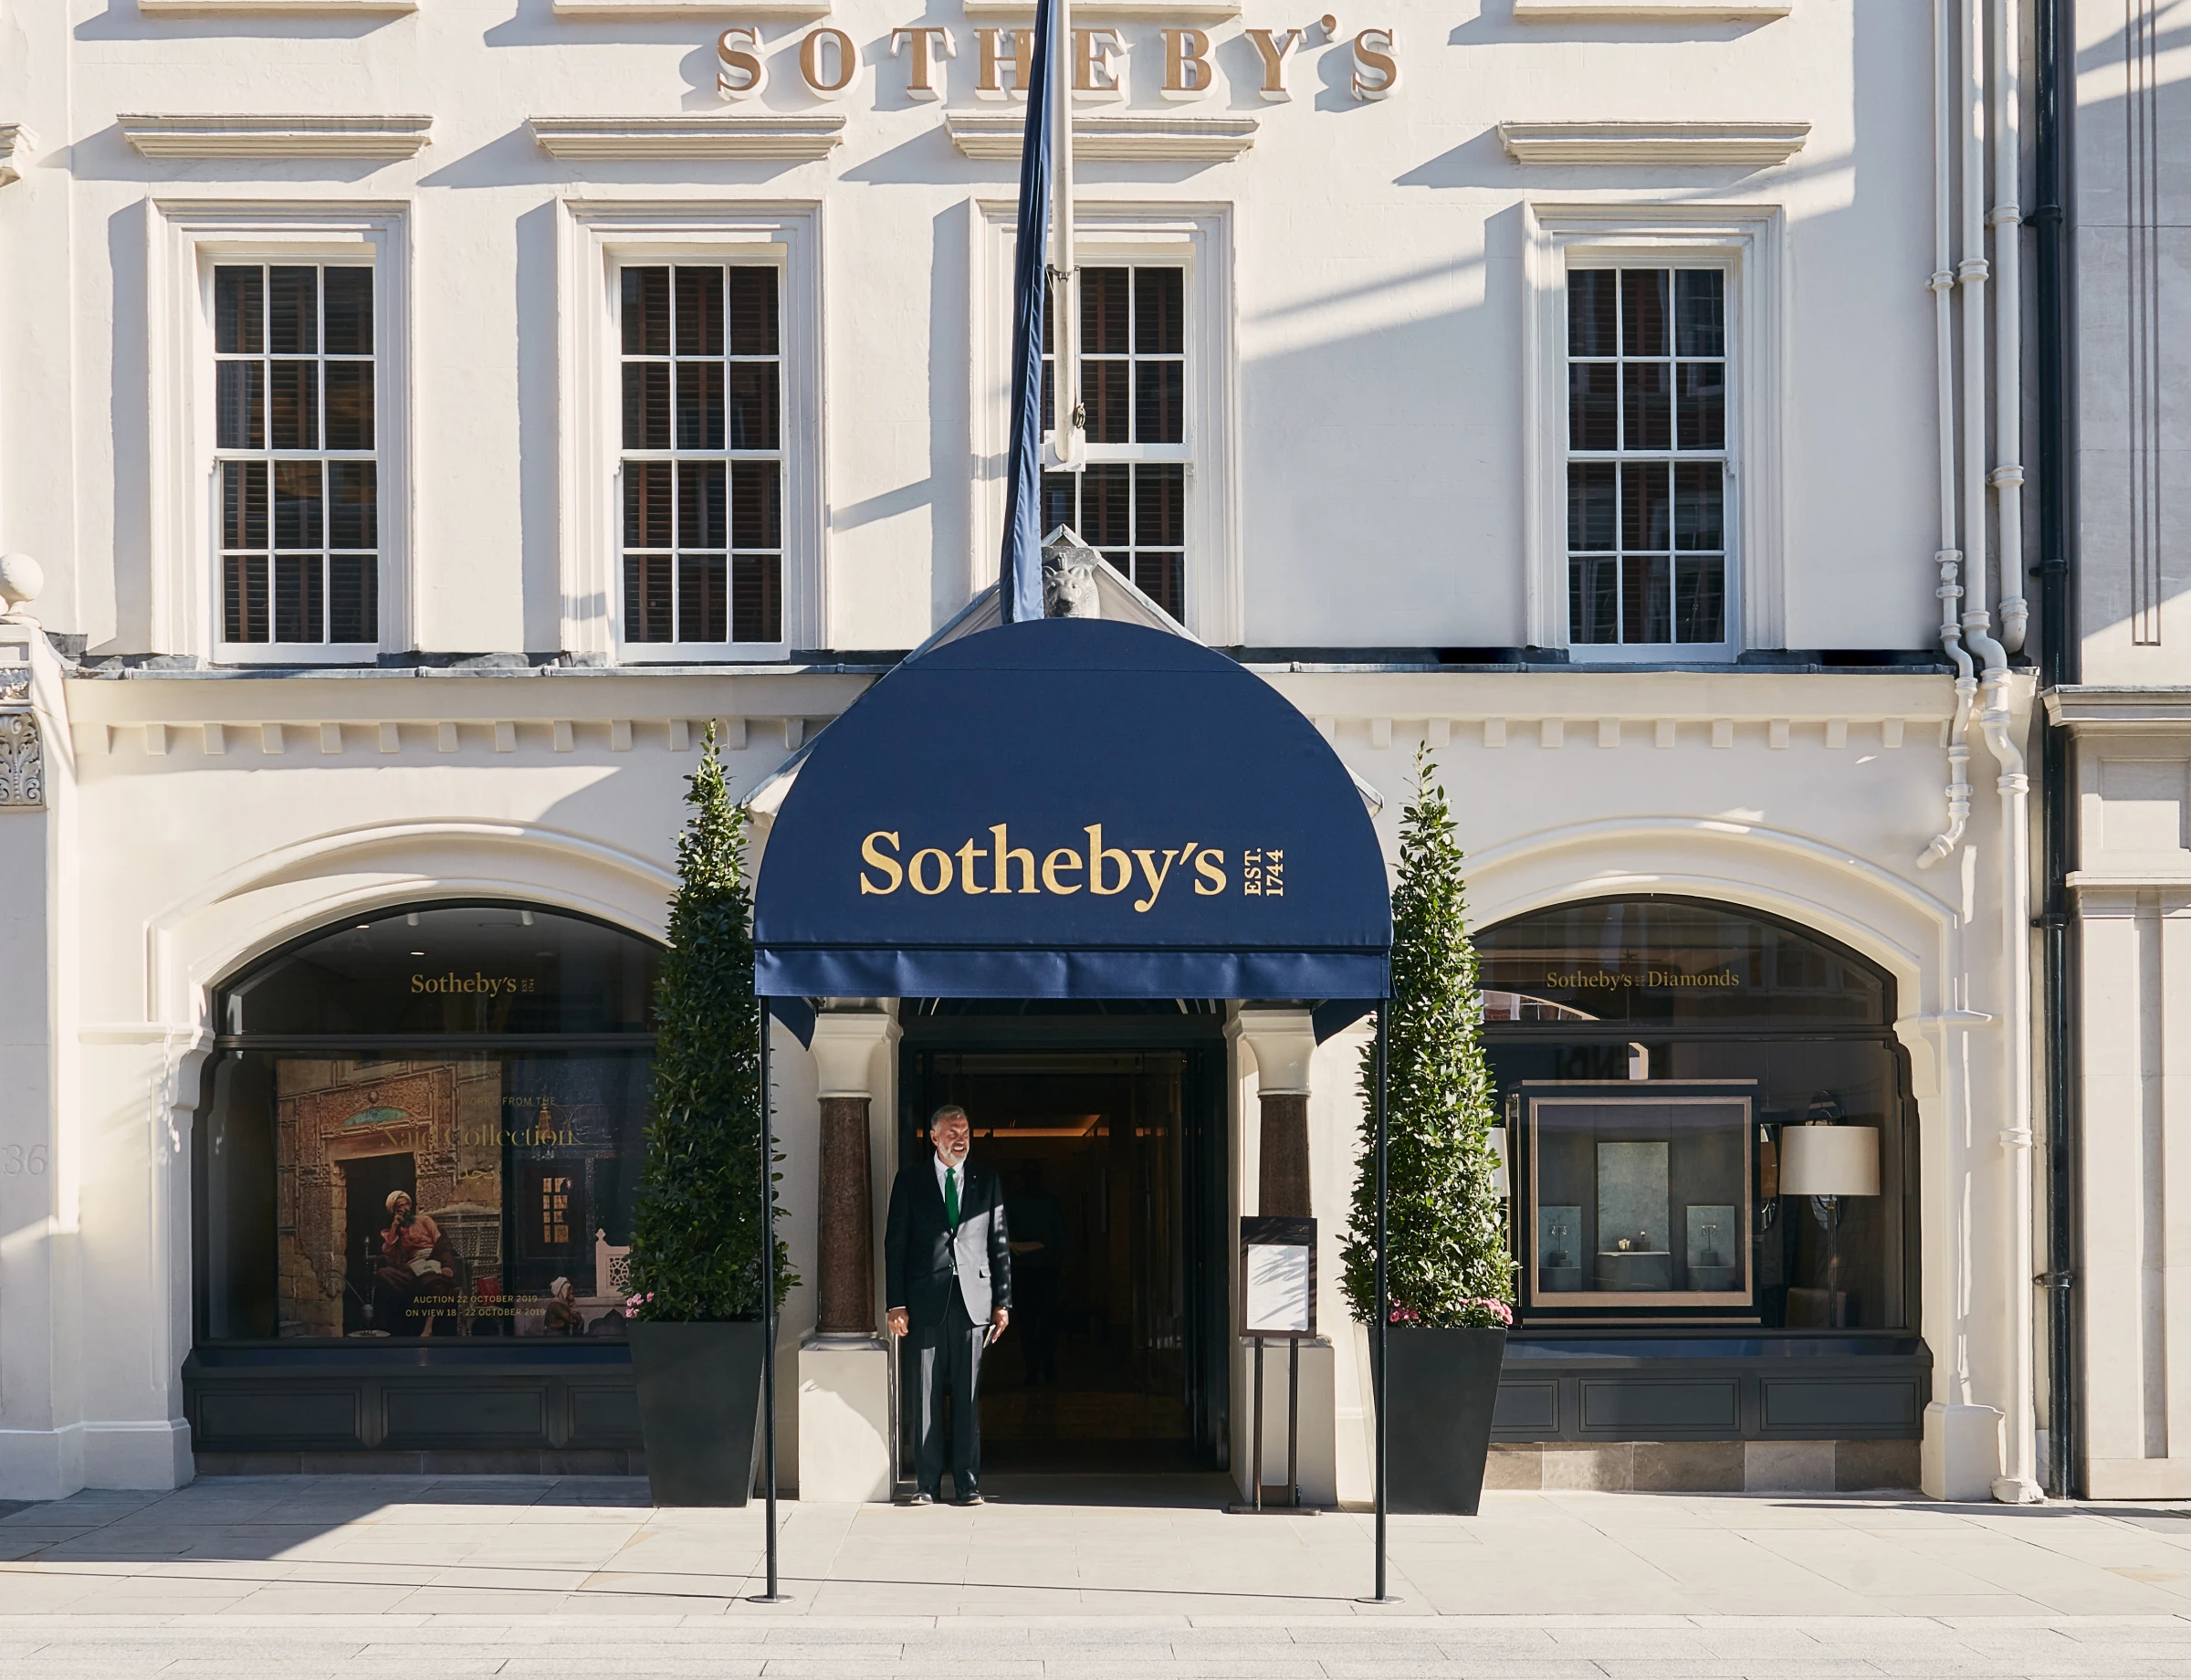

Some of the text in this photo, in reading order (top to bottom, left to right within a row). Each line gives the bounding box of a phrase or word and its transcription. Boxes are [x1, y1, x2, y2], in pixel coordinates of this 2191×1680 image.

[716, 14, 1401, 99] SOTHEBY'S
[860, 823, 1227, 913] Sotheby's
[1244, 847, 1262, 897] EST.
[1265, 849, 1284, 897] 1744
[411, 971, 518, 998] Sotheby's
[1546, 971, 1632, 992] Sotheby's
[1648, 969, 1739, 987] Diamonds
[460, 1097, 556, 1107] WORKS FROM THE
[444, 1123, 574, 1147] Collection
[2, 1143, 48, 1176] 36
[405, 1308, 420, 1318] ON
[421, 1308, 444, 1318] VIEW
[446, 1308, 457, 1318] 18
[465, 1308, 476, 1317] 22
[478, 1308, 521, 1317] OCTOBER
[524, 1307, 546, 1317] 2019
[414, 1295, 538, 1304] AUCTION 22 OCTOBER 2019
